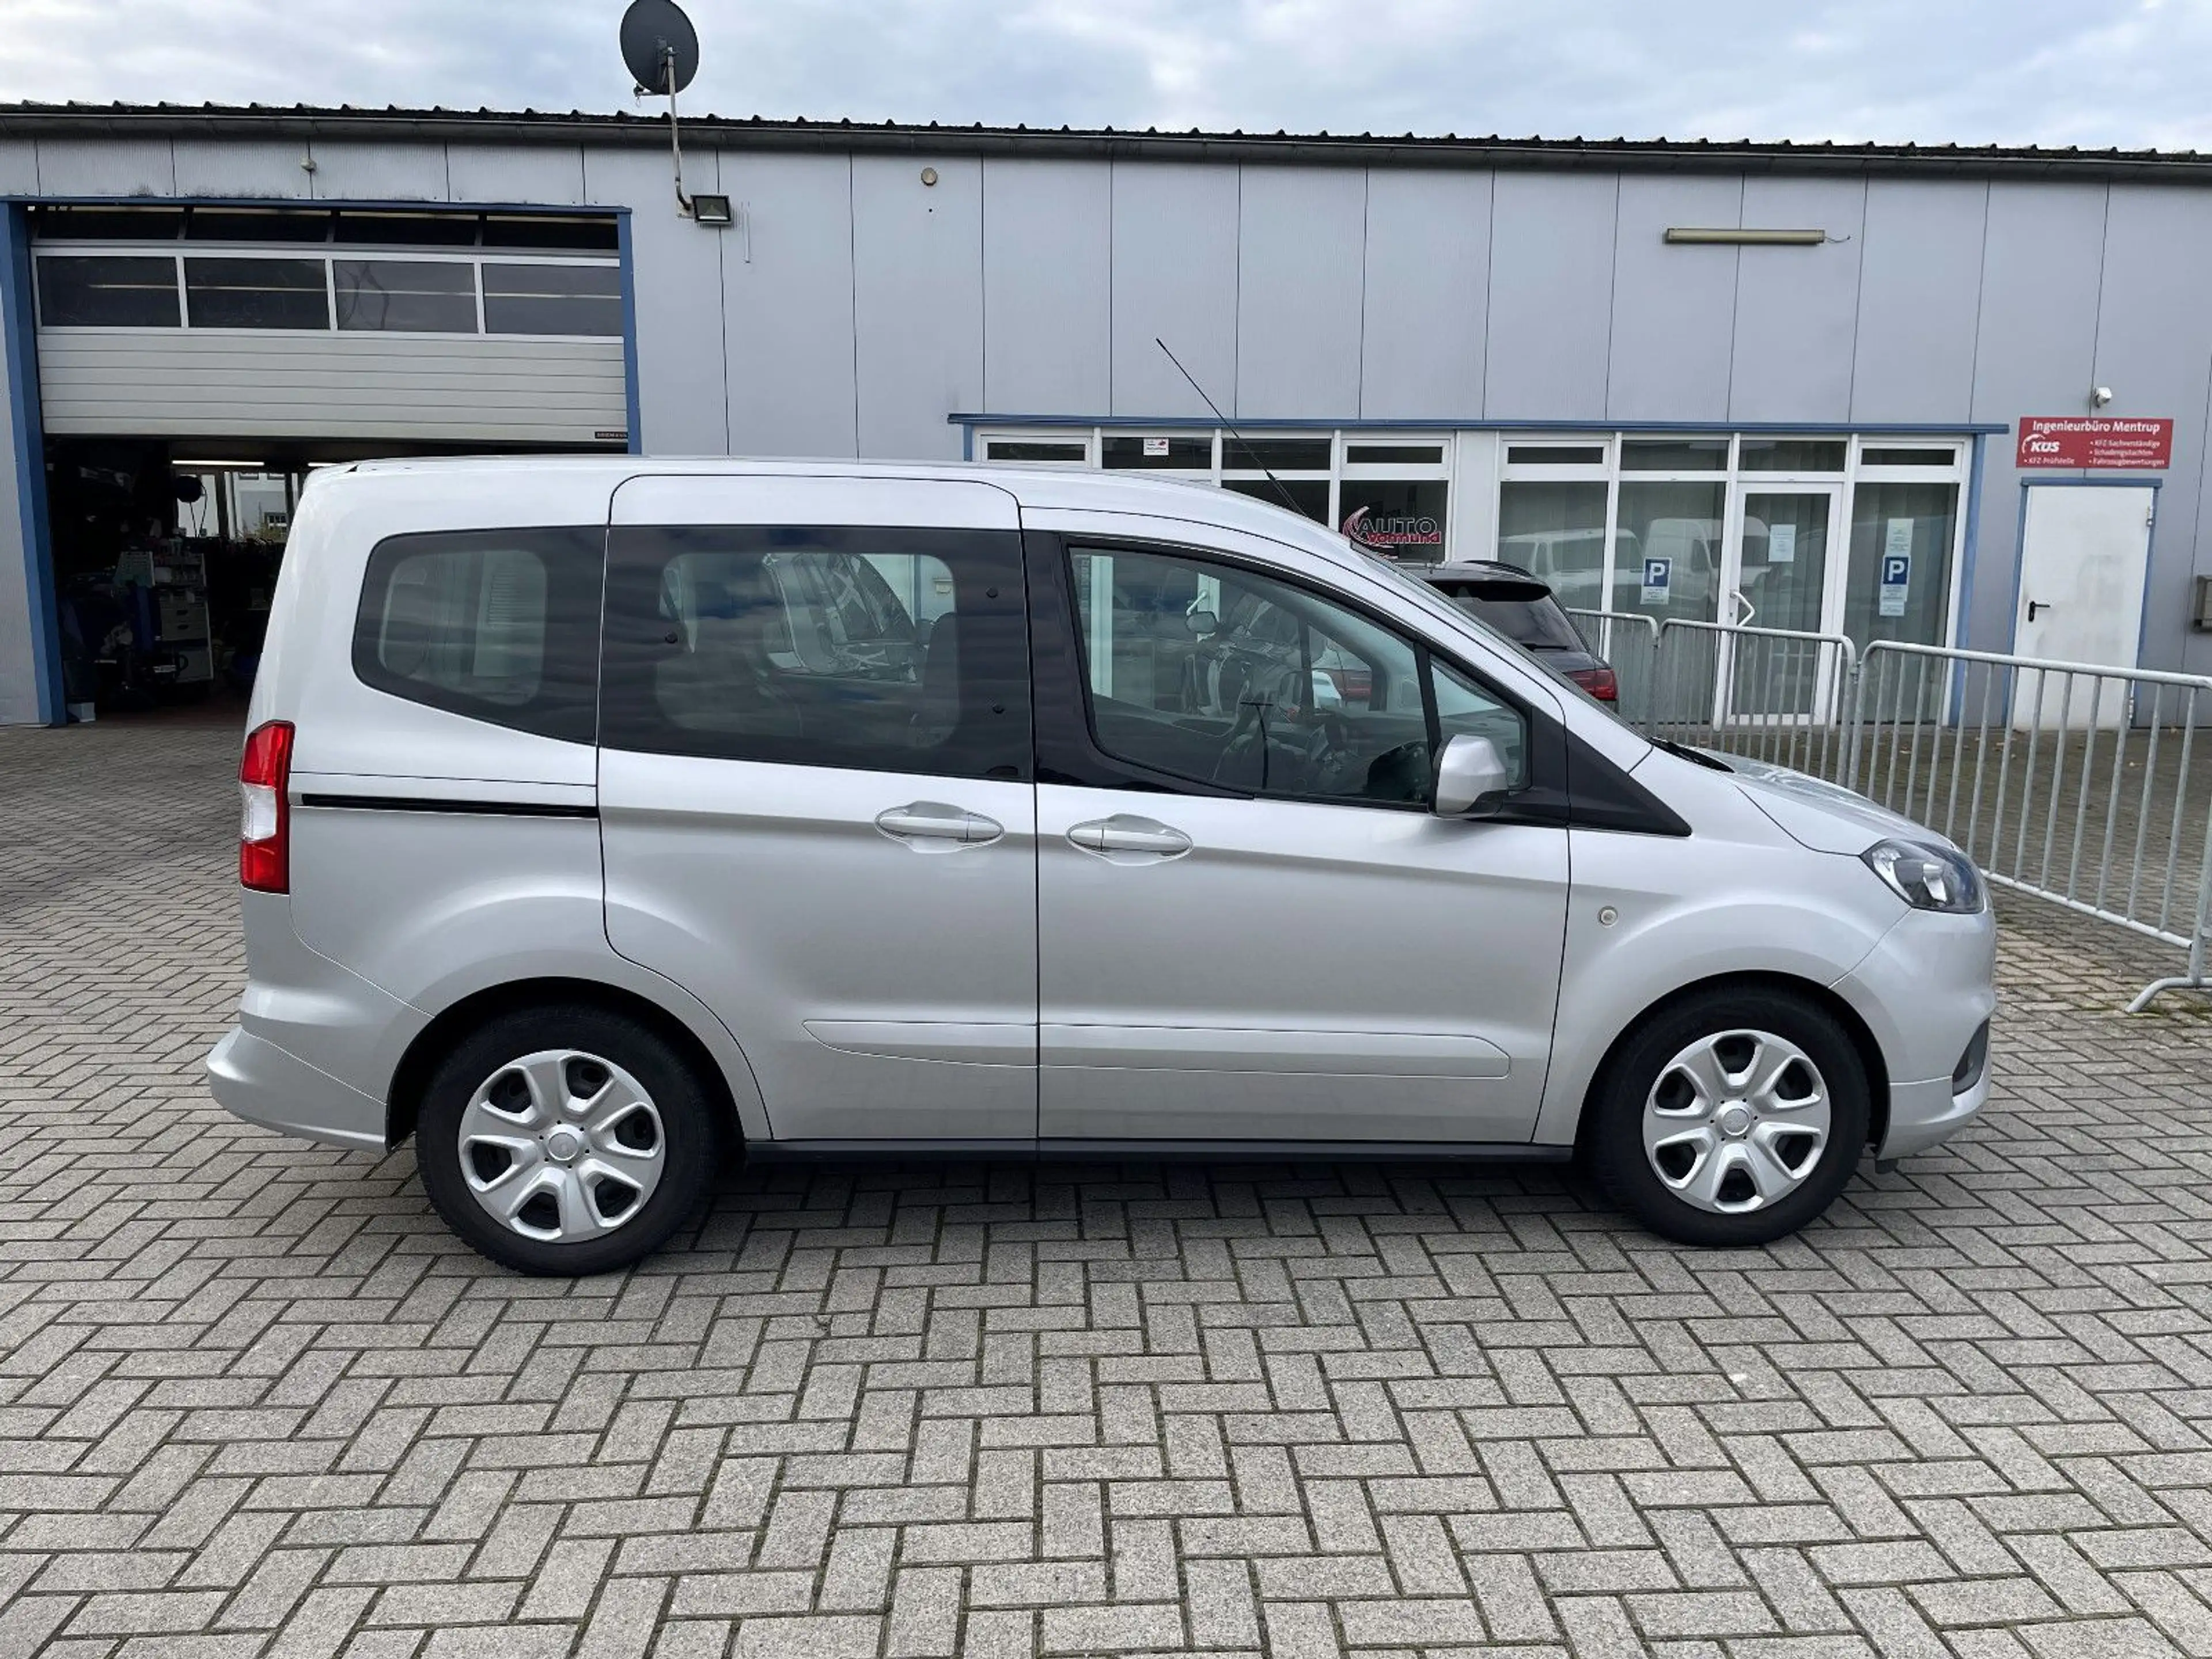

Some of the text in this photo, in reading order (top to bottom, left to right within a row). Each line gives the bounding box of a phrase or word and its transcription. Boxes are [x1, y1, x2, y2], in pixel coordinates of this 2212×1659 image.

[2033, 420, 2160, 435] Ingenieurbüro Mentrup
[1357, 517, 1437, 535] AUTO
[1649, 562, 1666, 584] P
[1888, 559, 1906, 582] P
